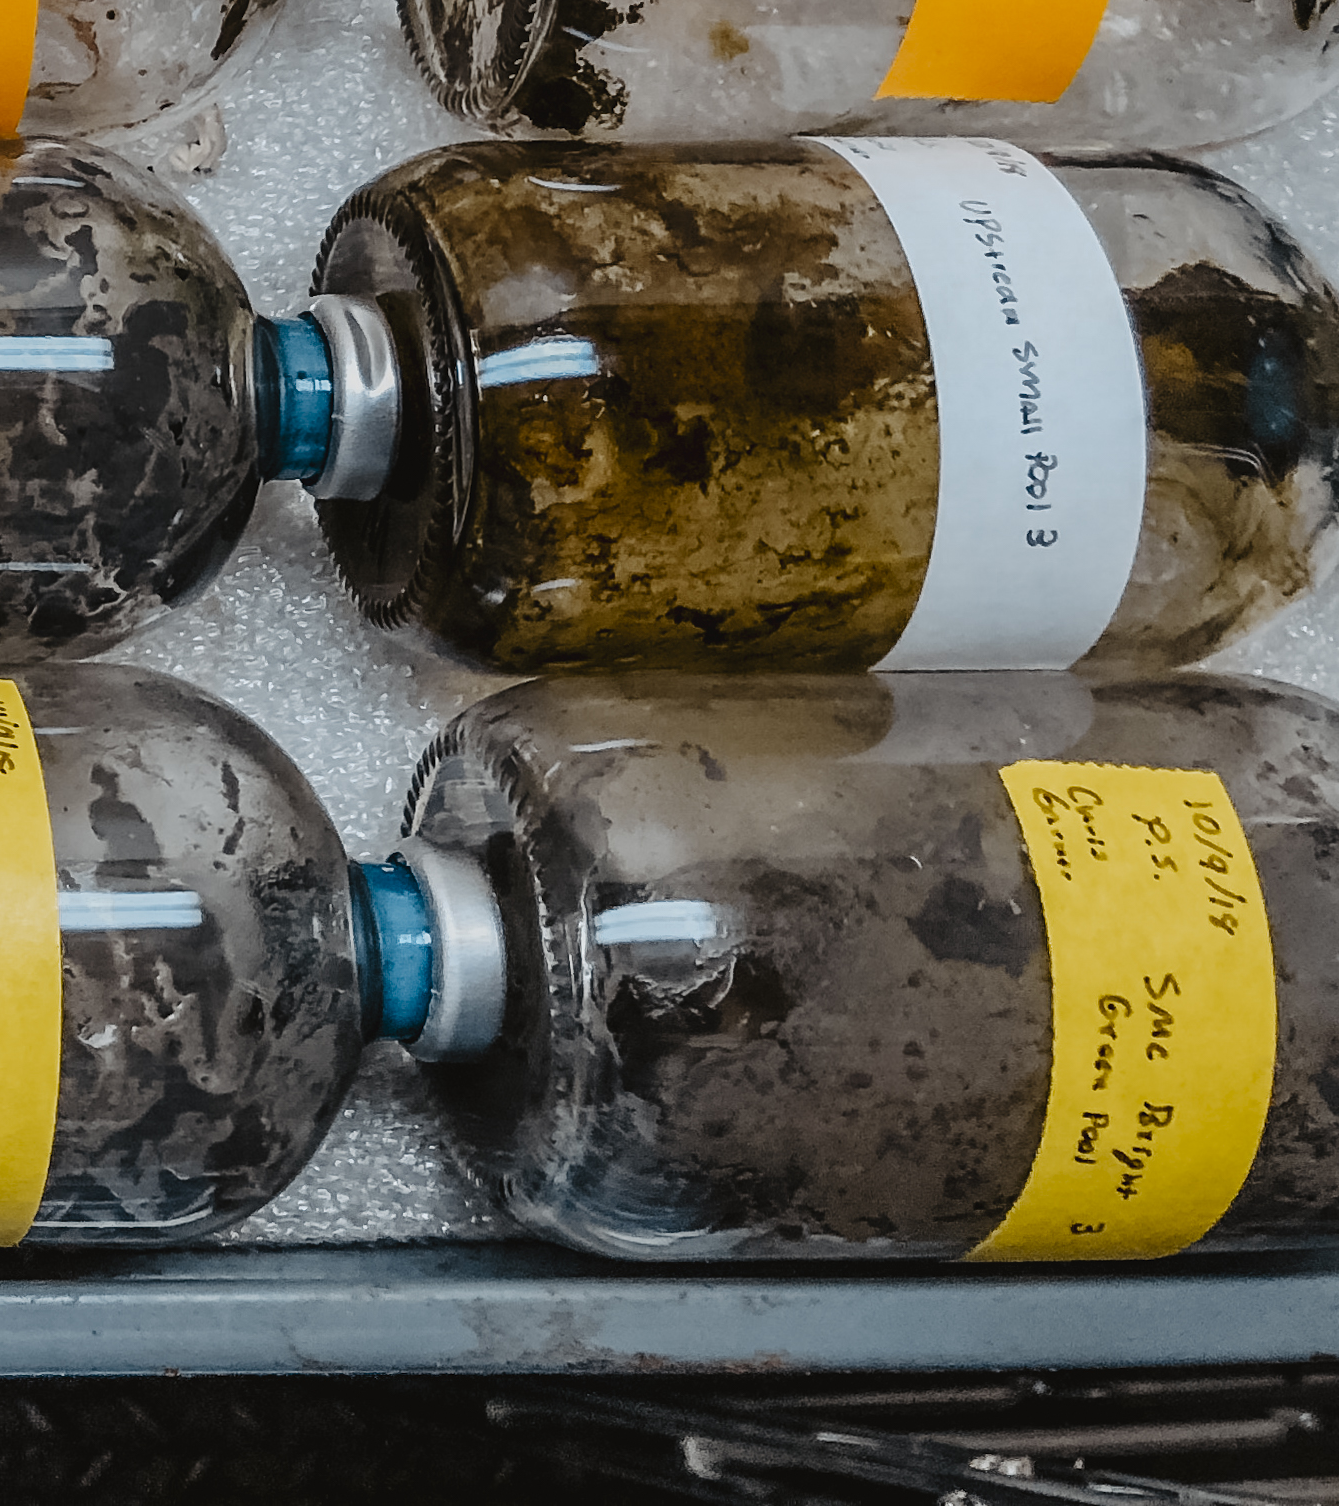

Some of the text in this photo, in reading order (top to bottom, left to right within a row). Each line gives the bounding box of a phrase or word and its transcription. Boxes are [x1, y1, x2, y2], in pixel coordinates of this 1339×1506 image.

[1024, 450, 1059, 512] Pool
[1025, 528, 1059, 549] 3
[1129, 811, 1179, 881] P.S.
[1182, 797, 1248, 937] 10/9/18
[1068, 994, 1134, 1237] Green Pool 3
[1111, 971, 1183, 1201] SMC Bright
